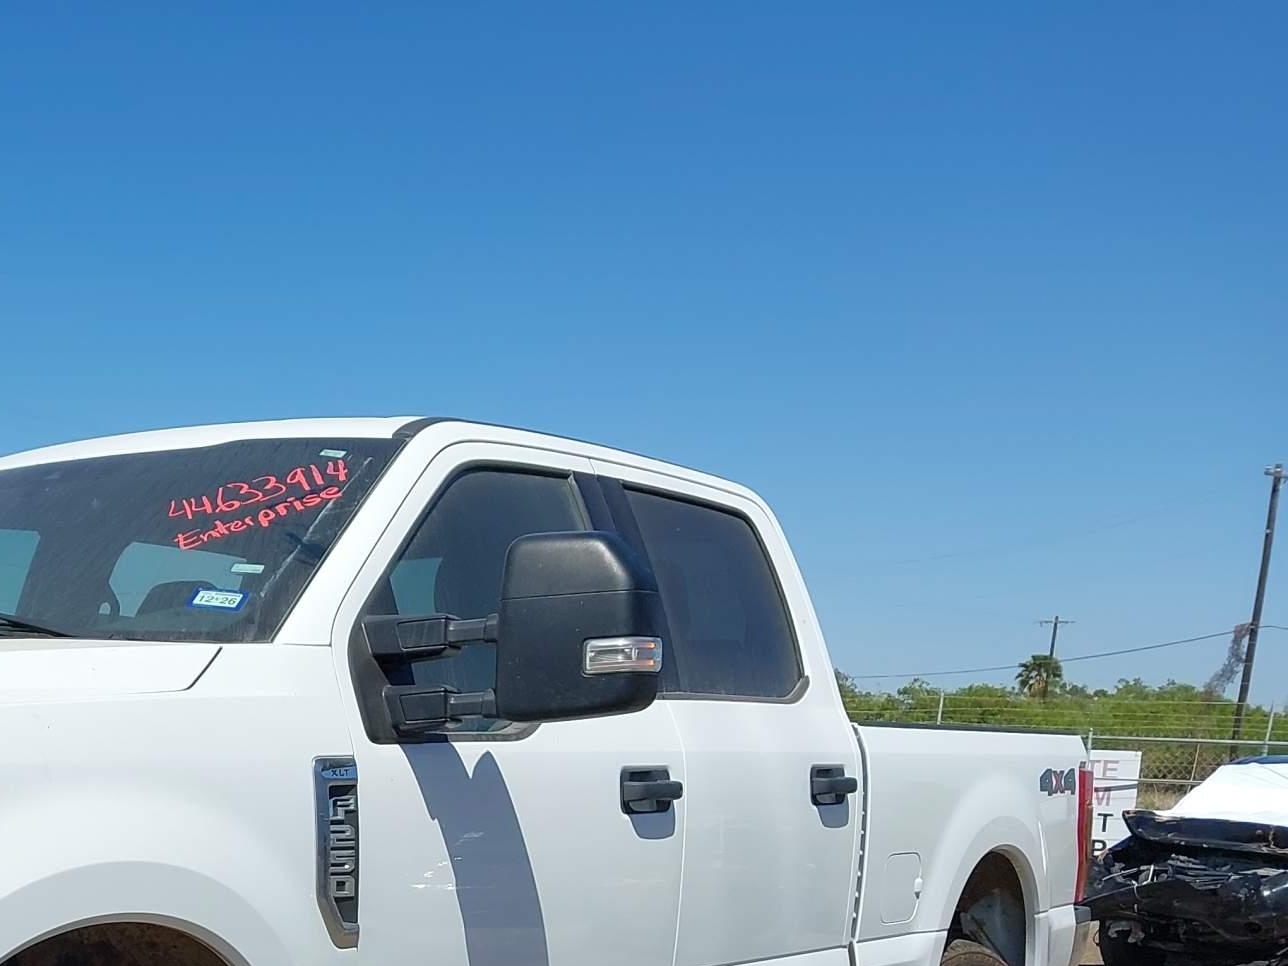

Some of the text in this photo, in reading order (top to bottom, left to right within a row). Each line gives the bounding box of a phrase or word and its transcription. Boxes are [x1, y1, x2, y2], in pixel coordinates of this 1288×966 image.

[168, 459, 349, 520] 44633914
[174, 484, 343, 550] Enterprise
[330, 768, 350, 777] XLT
